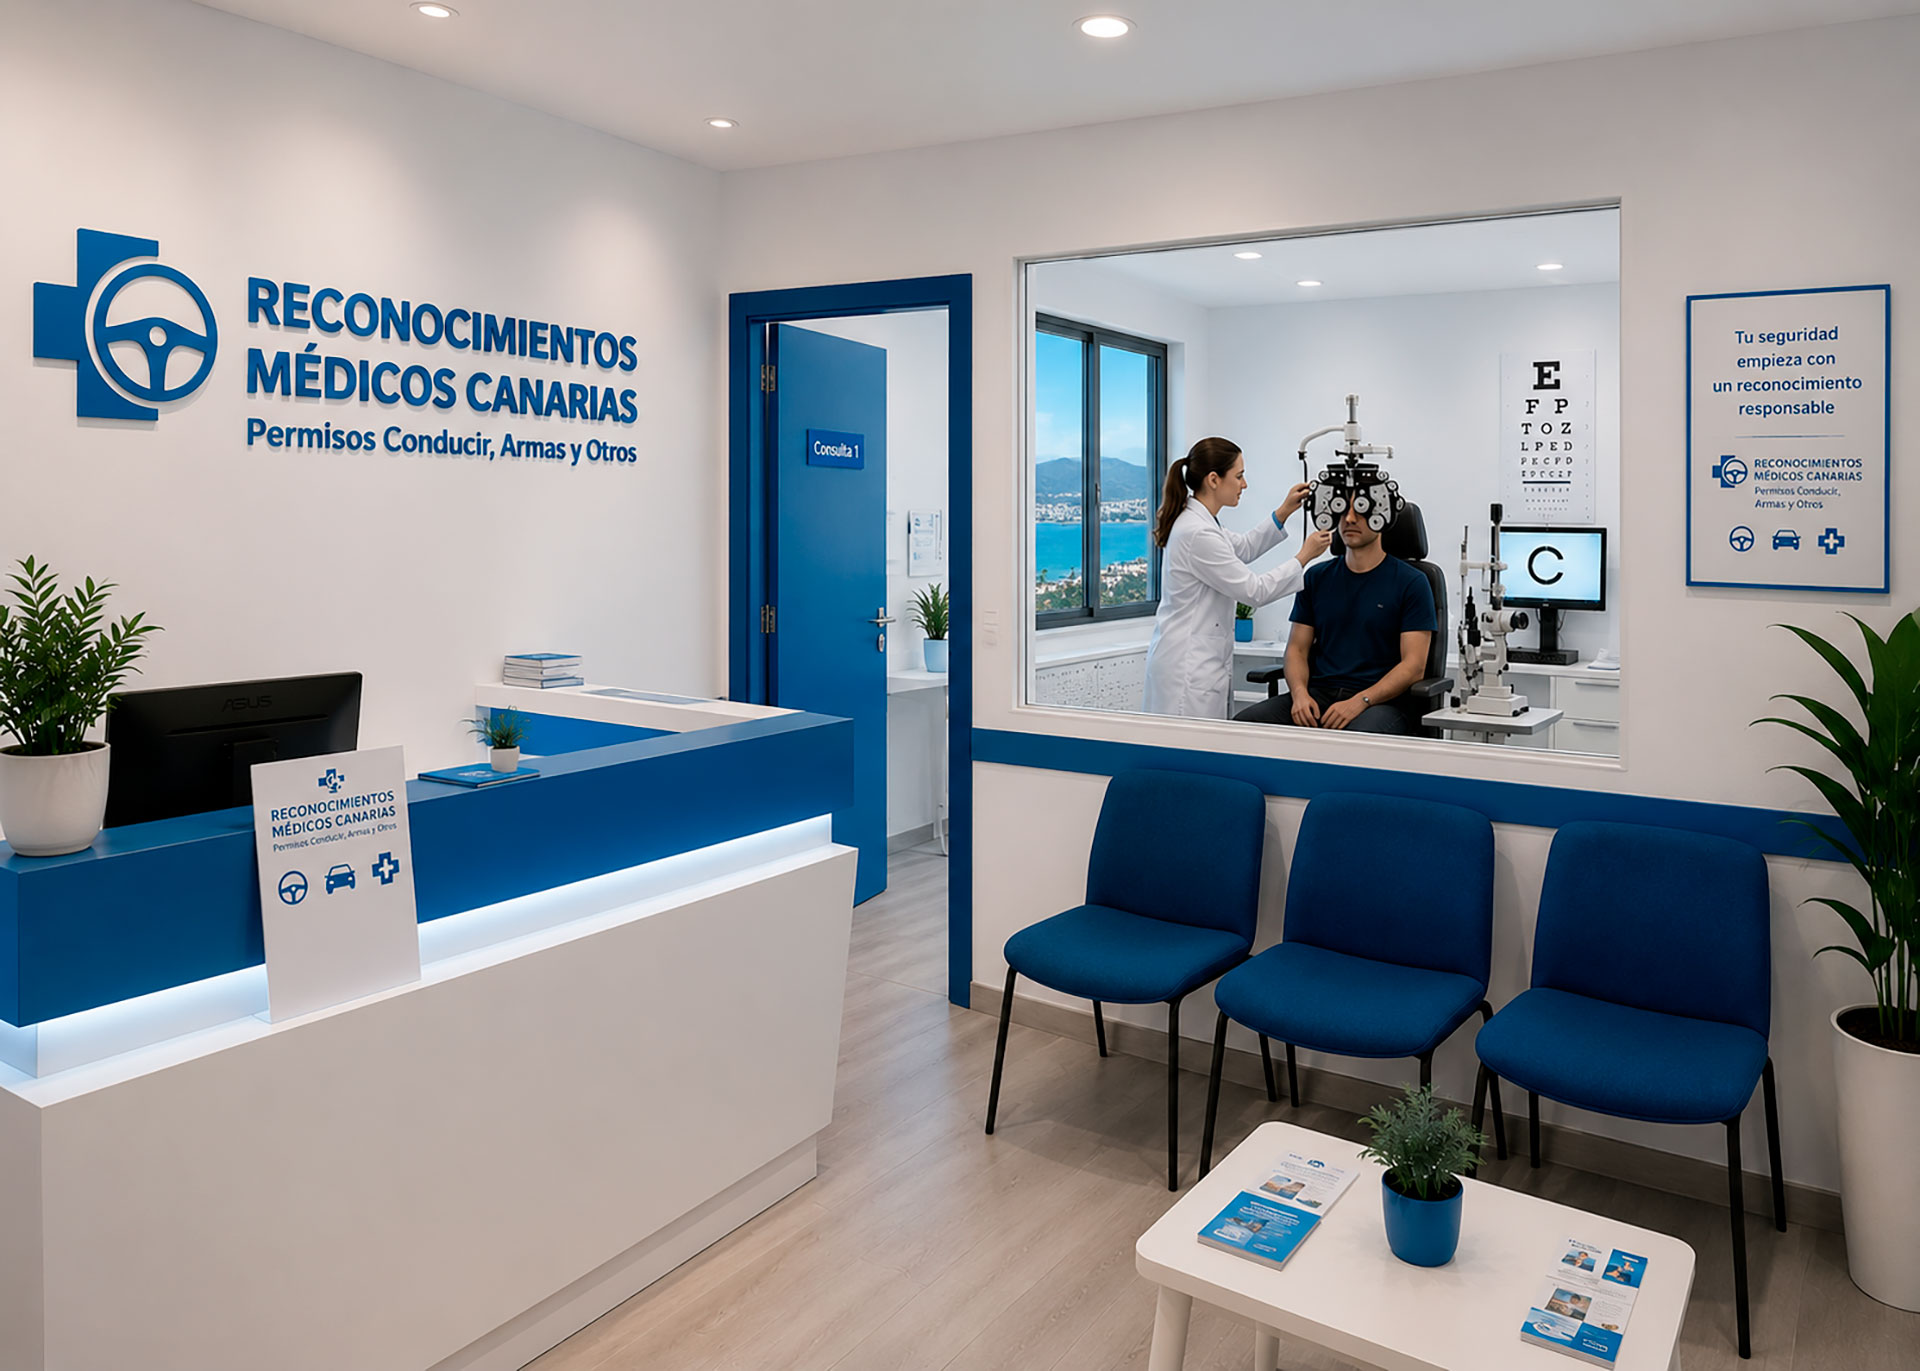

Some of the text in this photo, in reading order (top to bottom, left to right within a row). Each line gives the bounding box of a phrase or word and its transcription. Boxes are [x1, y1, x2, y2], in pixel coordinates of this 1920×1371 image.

[247, 276, 638, 372] RECONOCIMIENTOS
[1734, 325, 1839, 346] Tu seguridad
[1736, 353, 1836, 371] empieza con
[247, 342, 638, 424] MÉDICOS CANARIAS
[1532, 360, 1561, 390] E
[1712, 376, 1863, 393] un reconocimiento
[1738, 399, 1836, 418] responsable
[247, 417, 638, 466] Permisos Conducir, Armas y Otros
[813, 440, 859, 459] Consulta 1
[1754, 458, 1863, 469] RECONOCIMIENTOS
[1753, 469, 1863, 481] MÉDICOS CANARIAS
[1754, 499, 1824, 512] Armas y Otros
[221, 695, 272, 712] ASUS
[270, 790, 395, 822] RECONOCIMIENTOS
[271, 805, 397, 839] MÉDICOS CANARIAS
